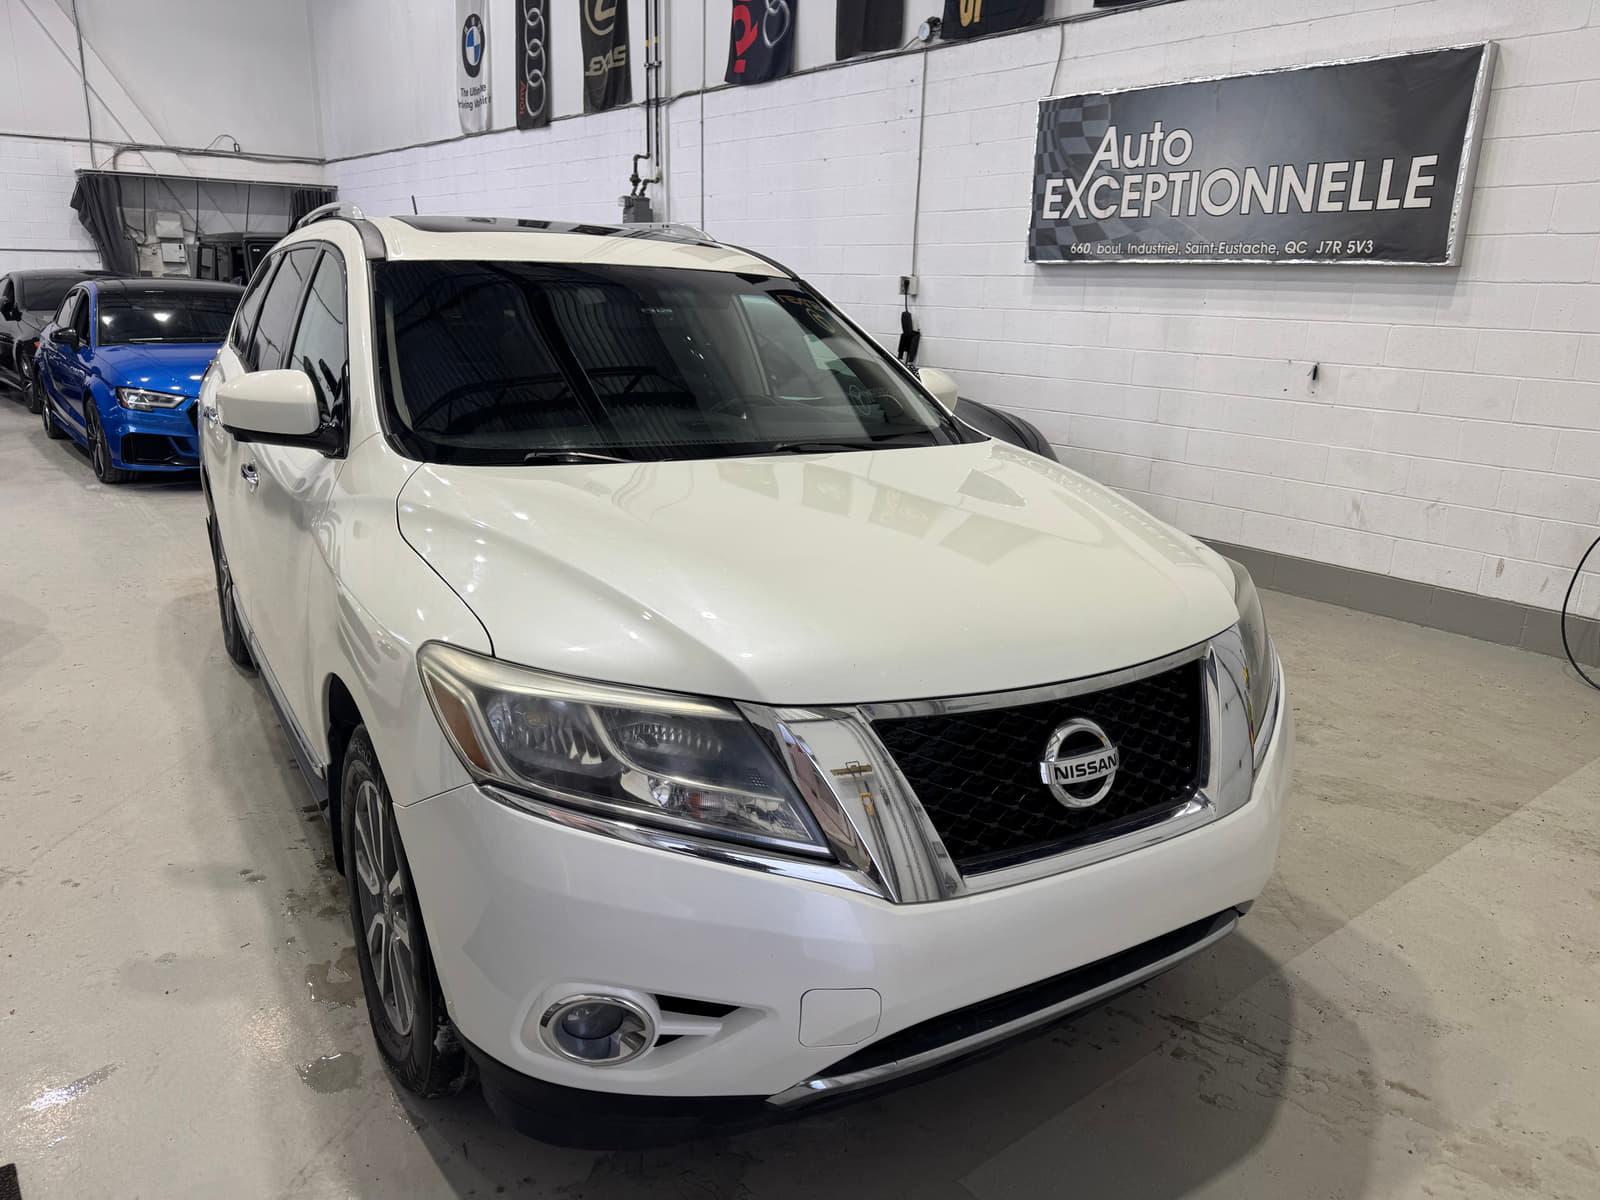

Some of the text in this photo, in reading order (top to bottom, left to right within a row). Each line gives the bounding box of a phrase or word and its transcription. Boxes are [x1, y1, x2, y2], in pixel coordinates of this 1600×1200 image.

[458, 99, 474, 111] riving
[1090, 121, 1194, 170] Auto
[1041, 153, 1439, 220] EXCEPTIONNELLE
[1070, 239, 1374, 256] 660, boul. Industriel, Saint-Eustache, QC J7R 5V3
[1054, 753, 1118, 781] NISSAN
